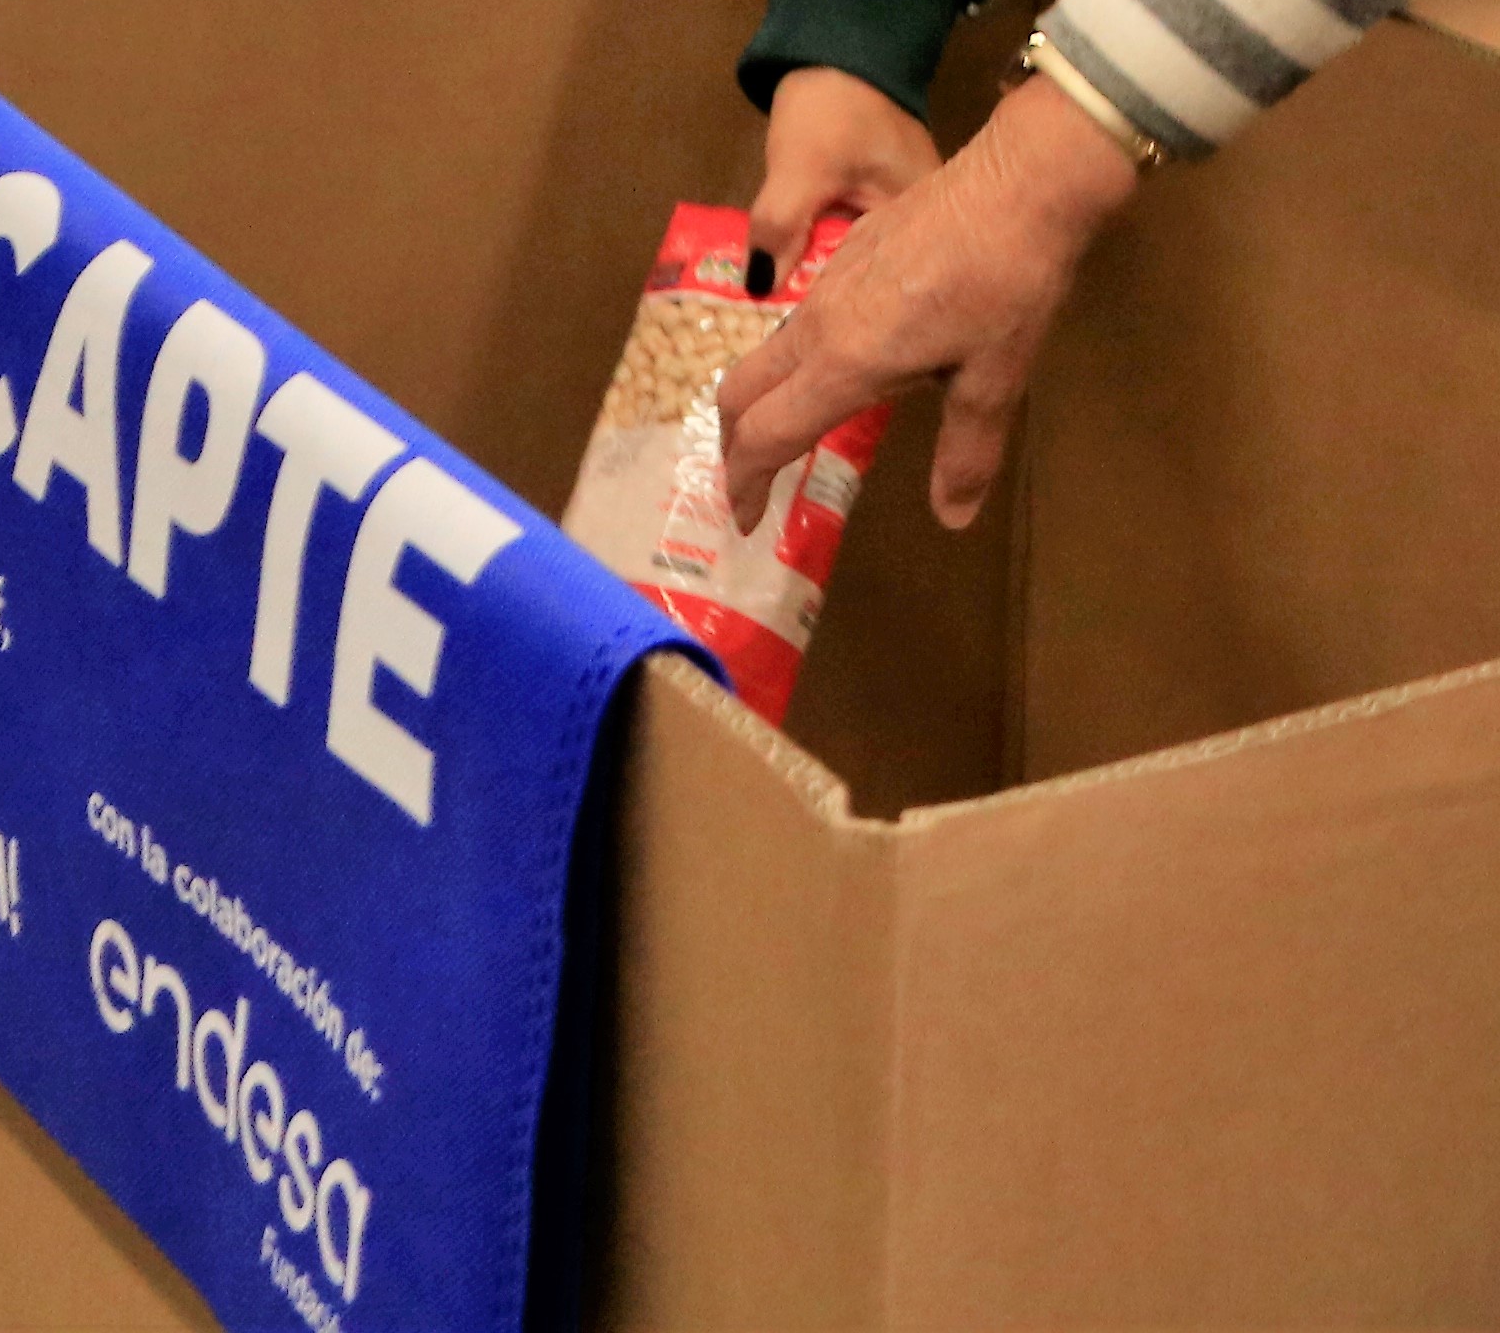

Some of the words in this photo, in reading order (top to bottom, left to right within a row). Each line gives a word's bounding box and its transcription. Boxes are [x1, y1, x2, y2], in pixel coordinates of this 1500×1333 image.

[87, 791, 137, 860] con
[140, 824, 169, 885] la
[172, 863, 345, 1052] colaboración
[88, 917, 372, 1305] endesa
